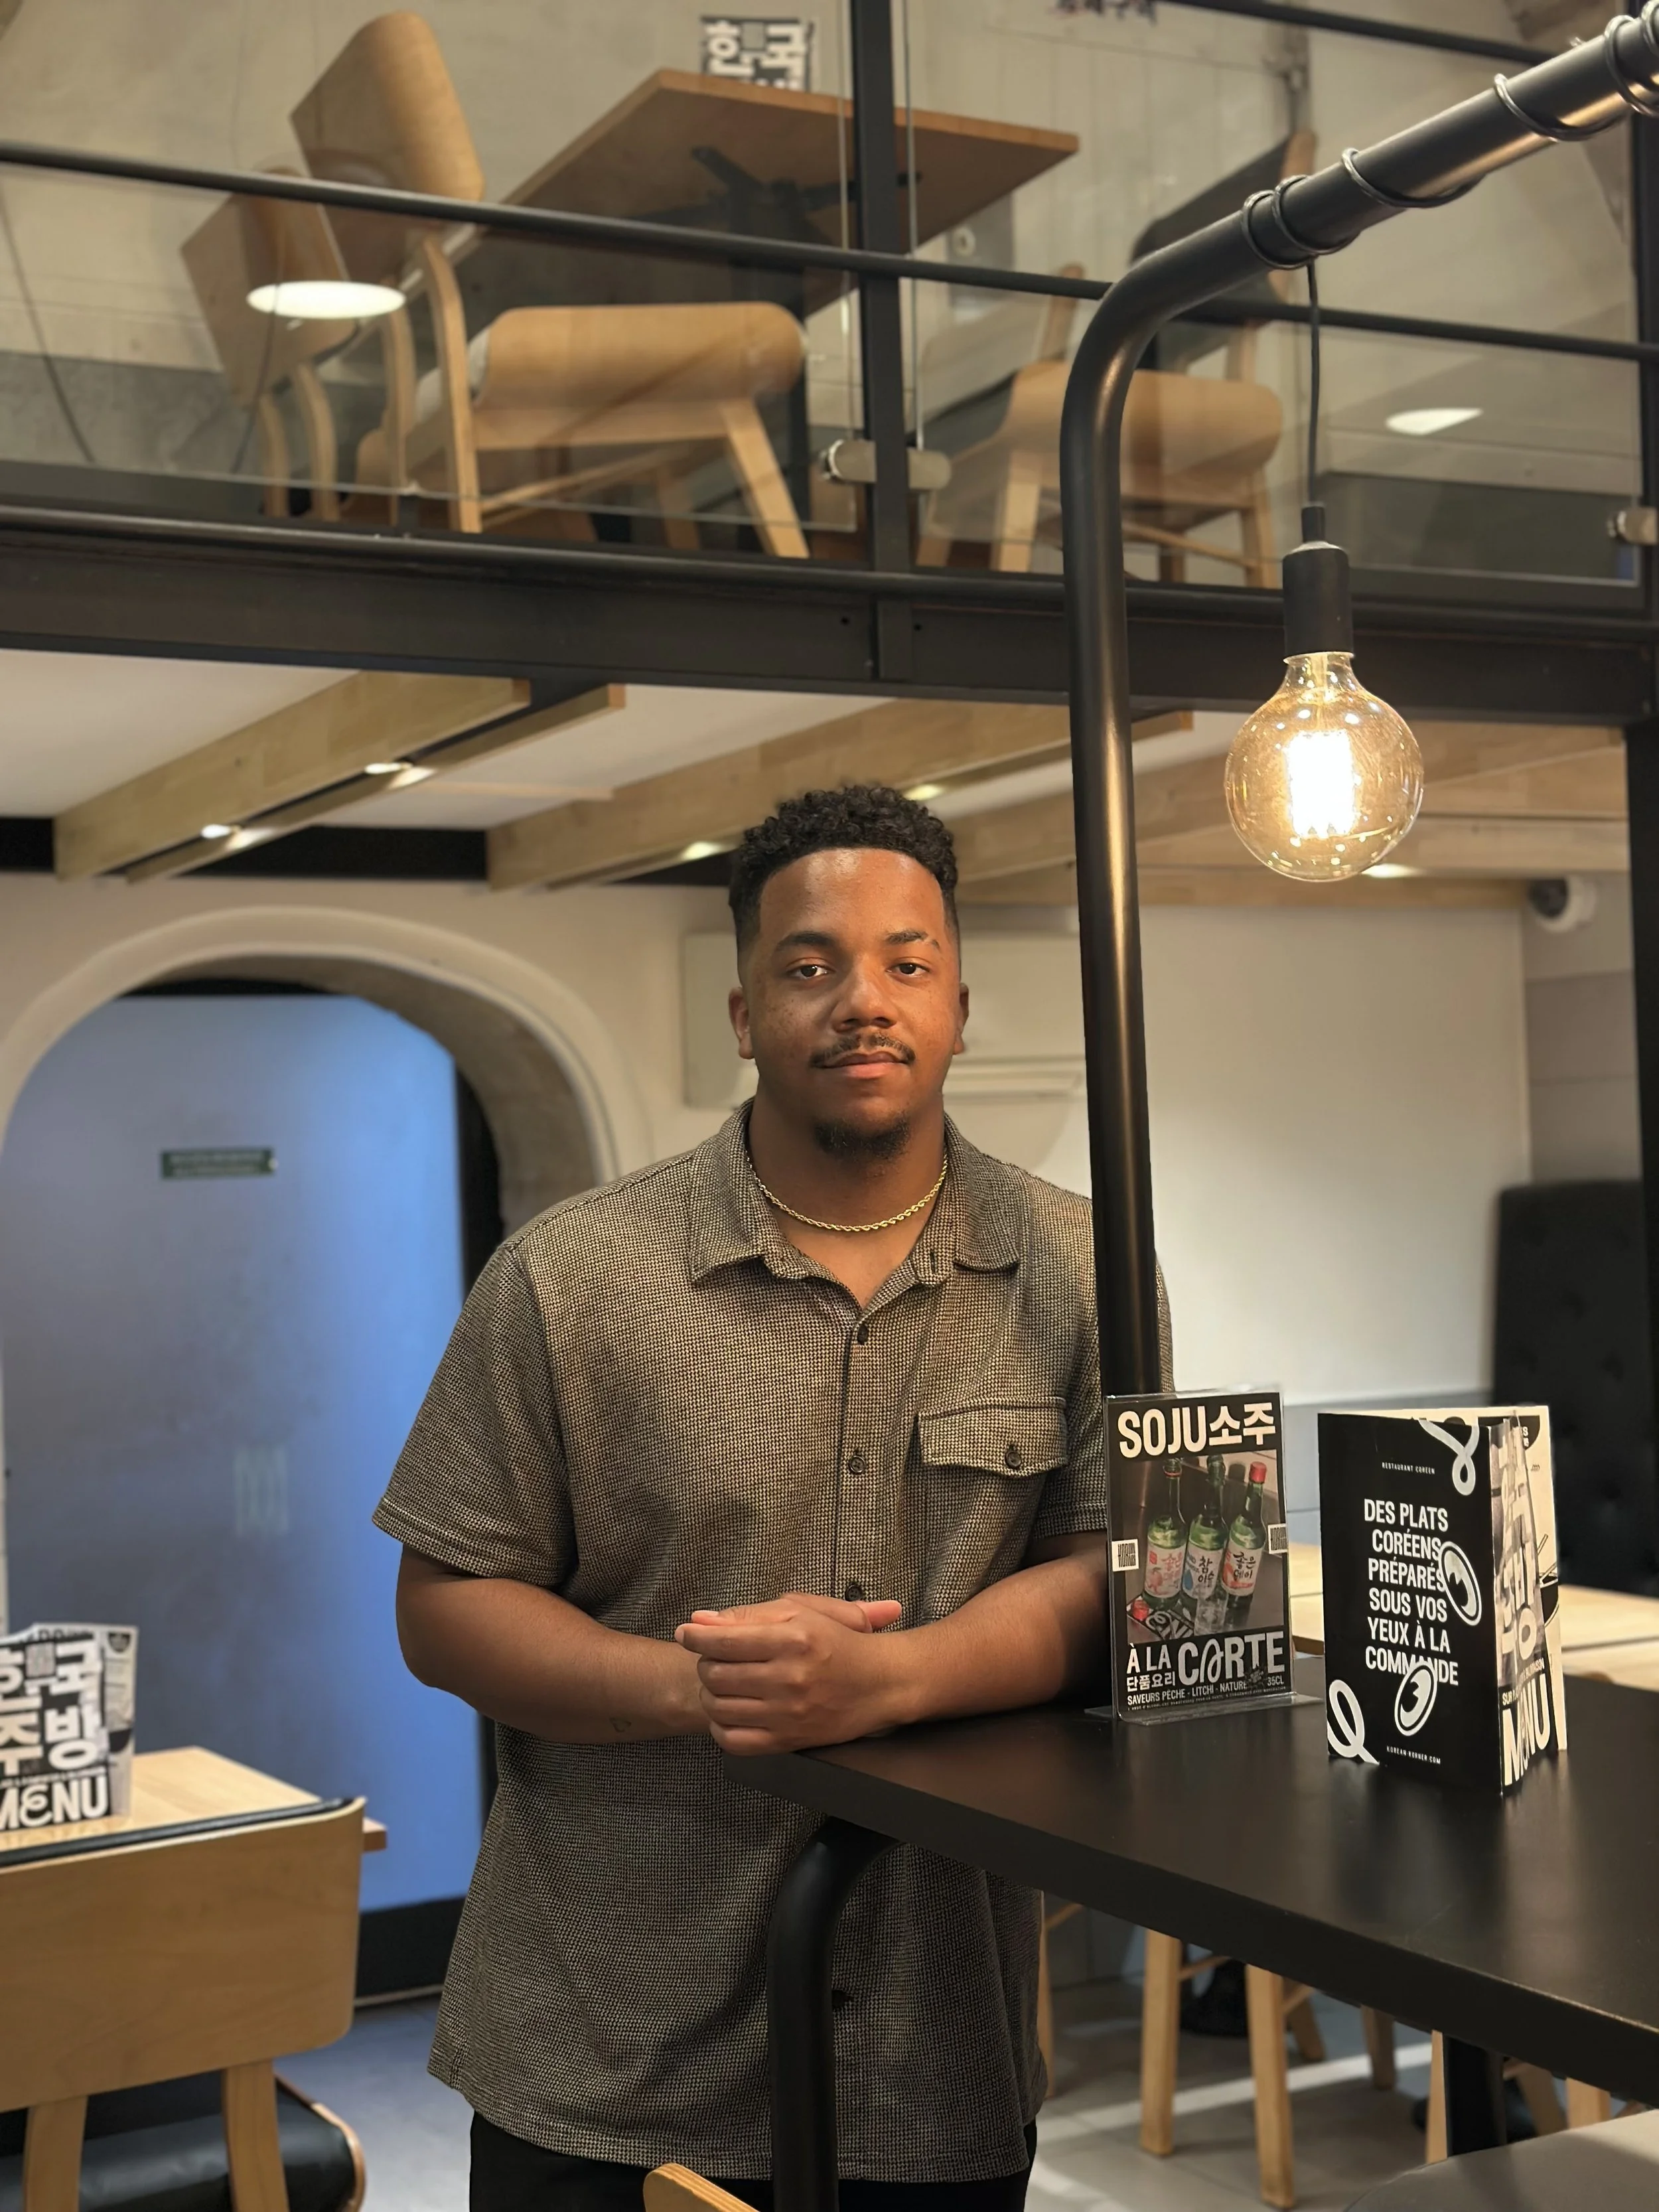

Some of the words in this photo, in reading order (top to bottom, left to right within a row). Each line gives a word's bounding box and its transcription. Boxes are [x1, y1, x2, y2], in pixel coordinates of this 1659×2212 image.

[1382, 1461, 1413, 1472] RESTAURANT
[1364, 1498, 1396, 1524] DES
[1400, 1503, 1449, 1532] PLATS
[1372, 1529, 1441, 1562] CORÉENS
[1368, 1556, 1446, 1591] PRÉPARÉS
[1369, 1587, 1411, 1617] SOUS
[1415, 1595, 1447, 1623] VOS
[1367, 1616, 1409, 1646] YEUX
[1414, 1621, 1425, 1650] À
[1430, 1628, 1451, 1654] LA
[1126, 1643, 1141, 1674] À
[1146, 1645, 1171, 1671] LA
[1178, 1631, 1285, 1686] CARTE
[1126, 1671, 1176, 1692] 단품요리
[1127, 1692, 1160, 1706] SAVEURS
[1192, 1684, 1214, 1697] LITCHI
[1220, 1680, 1248, 1692] NATURE
[1267, 1675, 1284, 1686] 35CL
